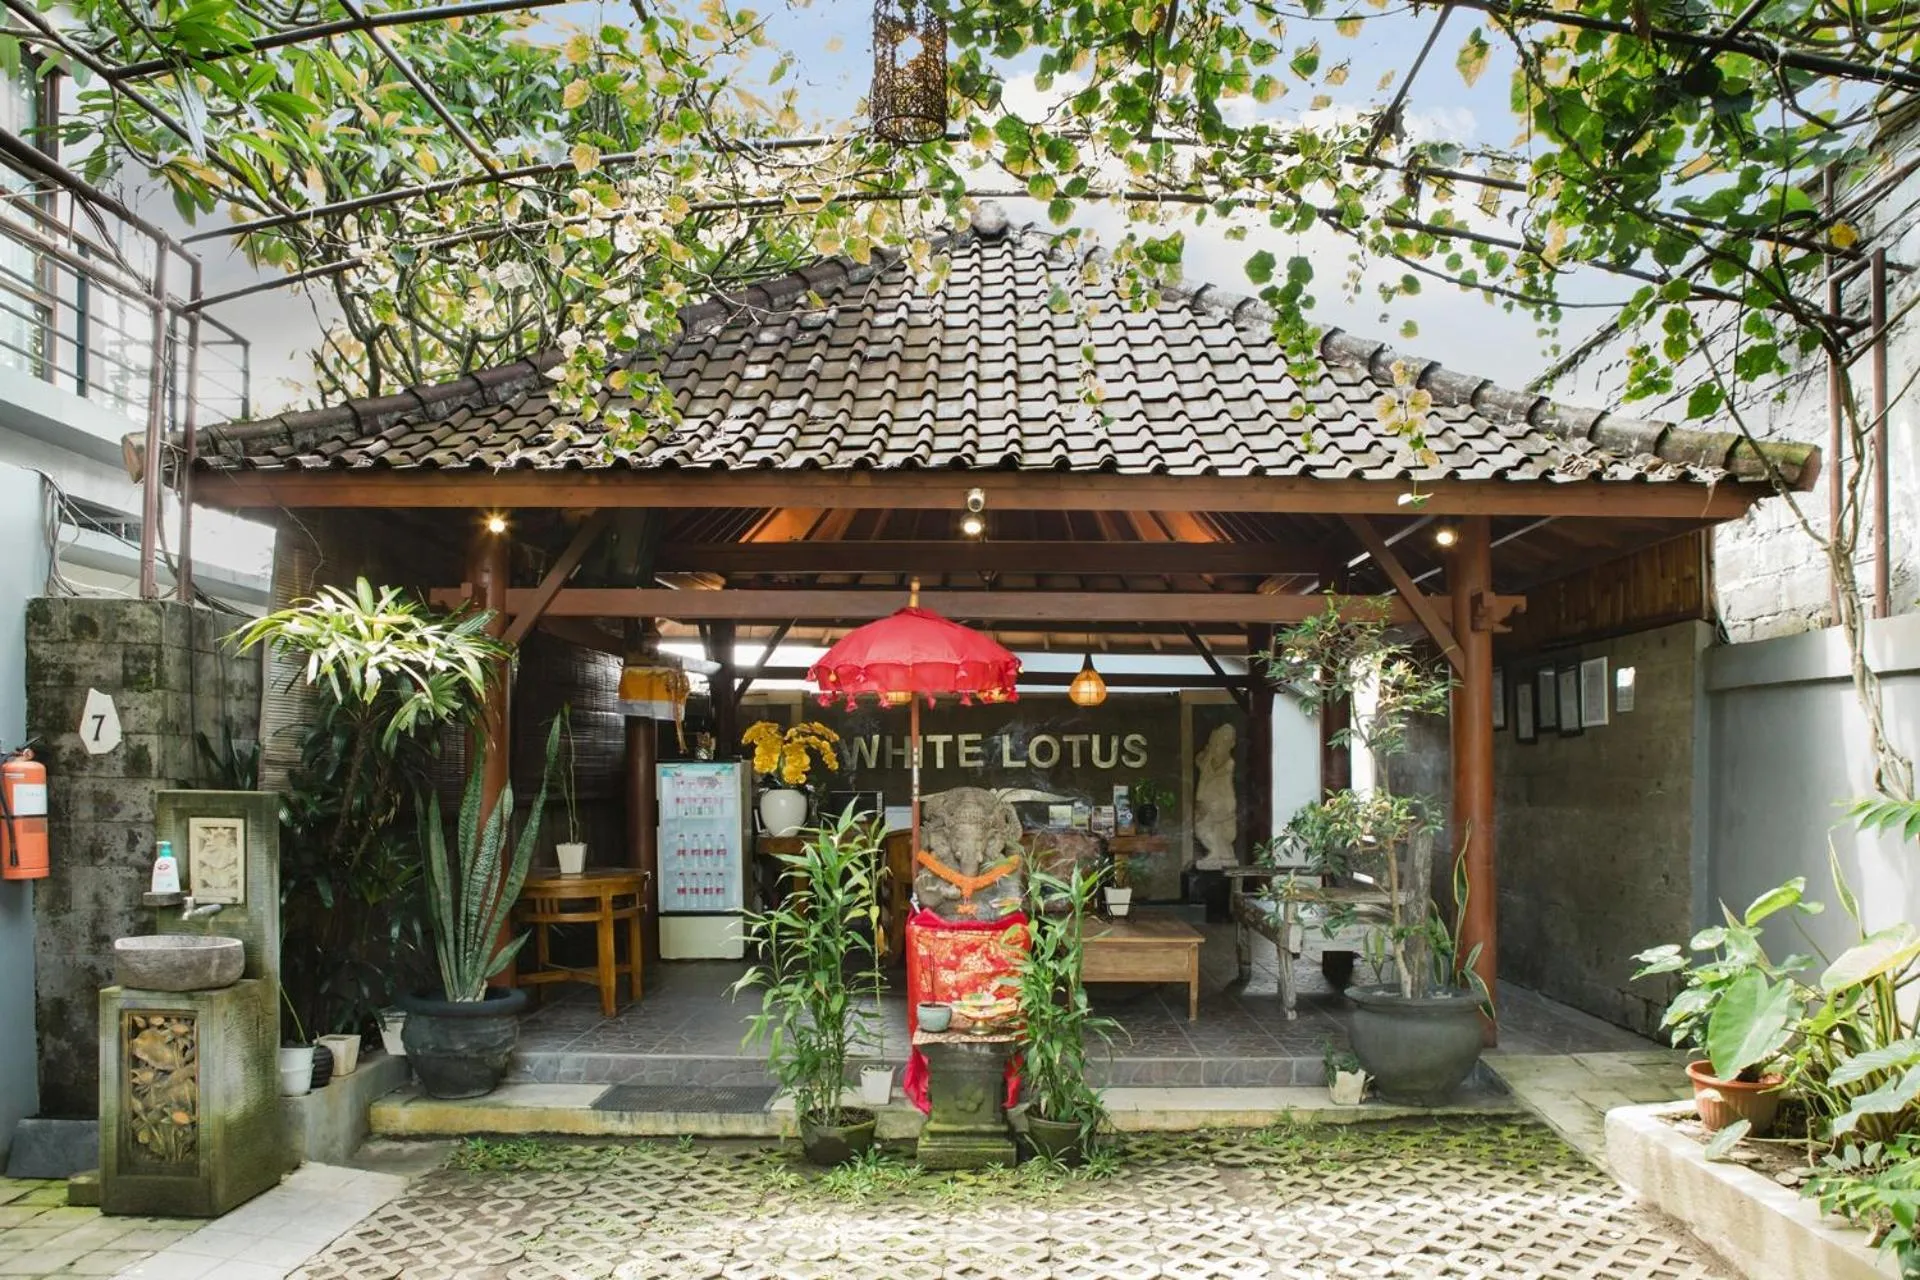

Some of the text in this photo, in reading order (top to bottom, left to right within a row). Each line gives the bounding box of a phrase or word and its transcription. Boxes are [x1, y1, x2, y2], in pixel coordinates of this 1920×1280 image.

[92, 714, 106, 742] 7
[840, 733, 1148, 769] WHITE LOTUS
